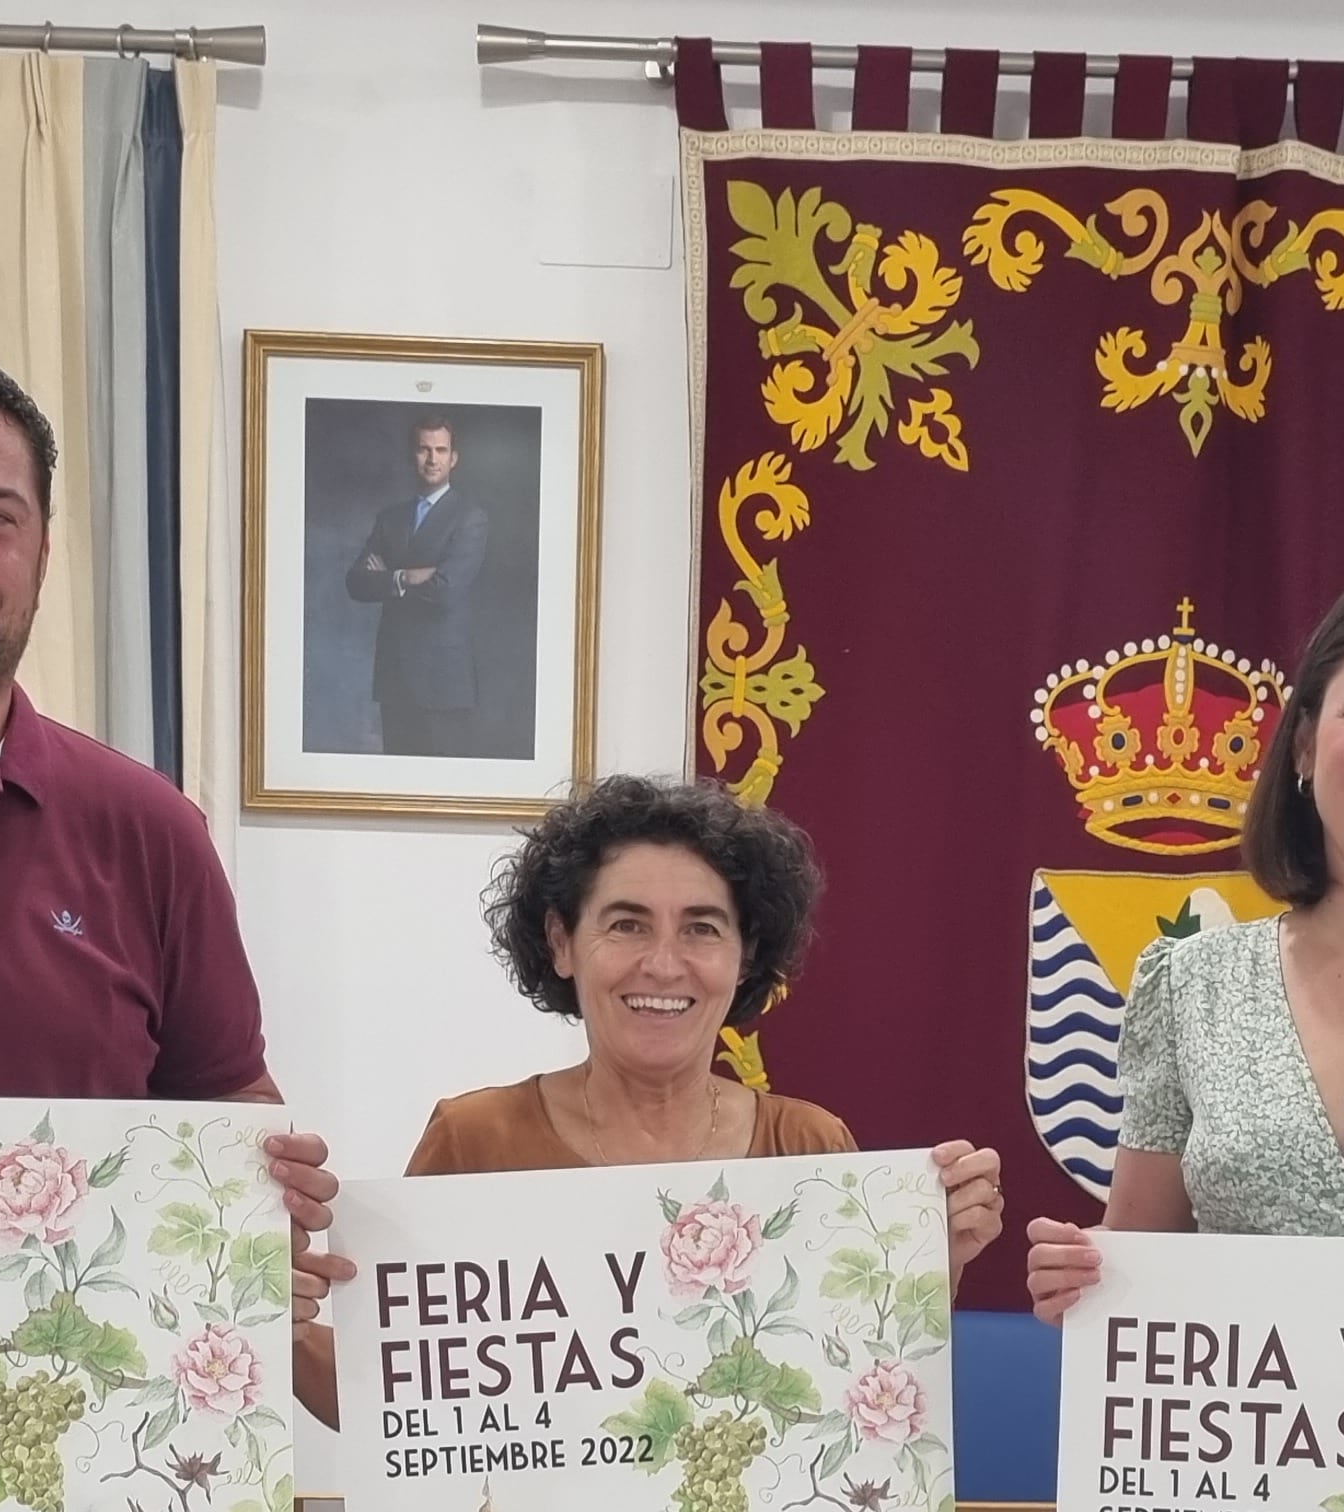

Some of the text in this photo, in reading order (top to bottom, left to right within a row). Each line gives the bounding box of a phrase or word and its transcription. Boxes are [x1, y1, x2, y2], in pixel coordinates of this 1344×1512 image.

[376, 1251, 646, 1329] FERIA Y
[381, 1327, 644, 1403] FIESTAS
[1106, 1317, 1297, 1390] FERIA
[382, 1401, 552, 1439] DEL 1 AL 4
[385, 1434, 654, 1478] SEPTIEMBRE 2022
[1099, 1465, 1271, 1502] DEL 1 AL 4
